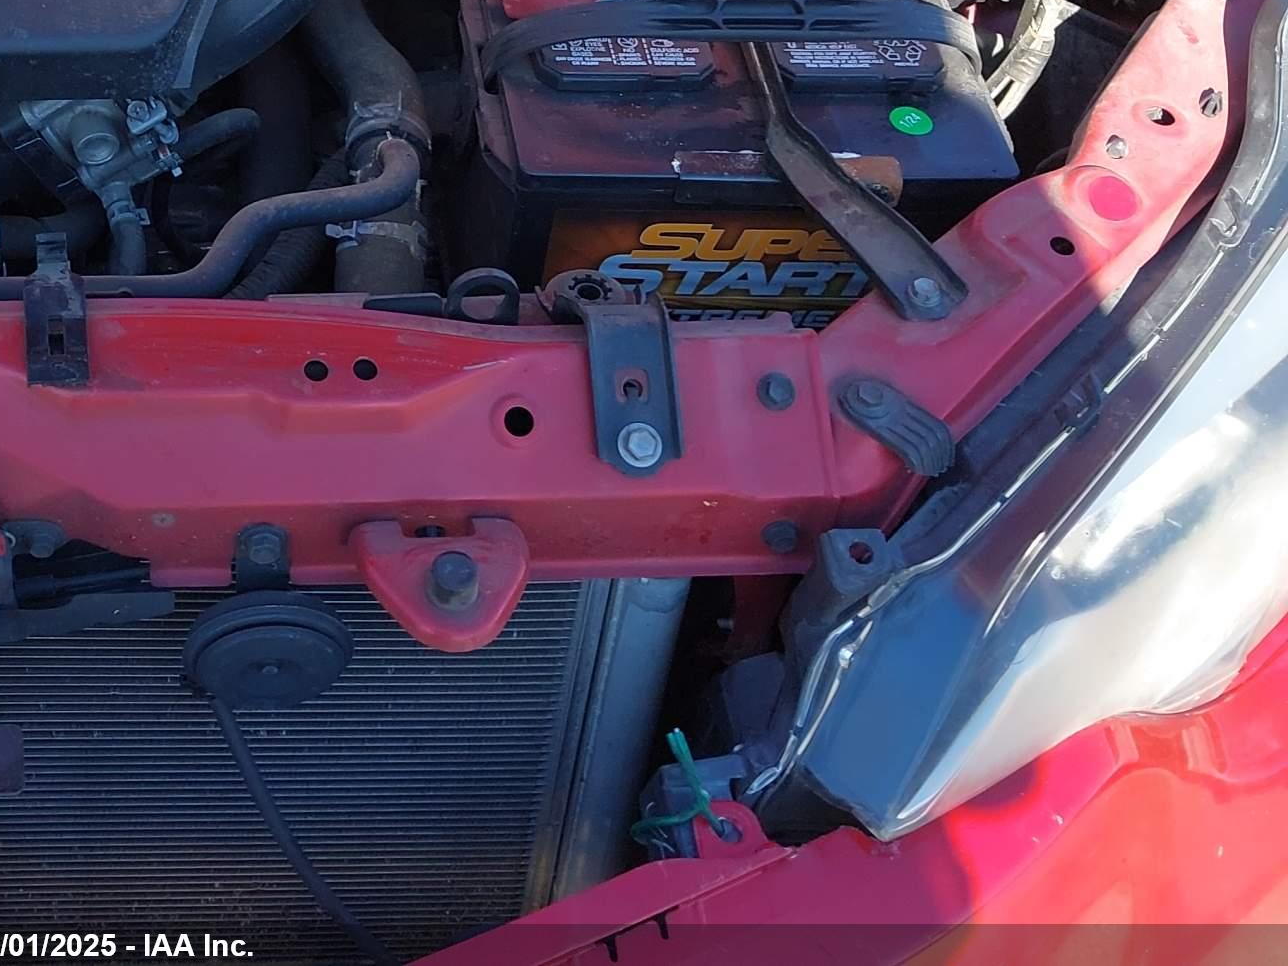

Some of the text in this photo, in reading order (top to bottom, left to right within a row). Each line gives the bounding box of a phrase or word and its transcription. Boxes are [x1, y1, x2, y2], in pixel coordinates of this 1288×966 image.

[899, 112, 922, 129] 1/24
[630, 222, 852, 262] SUPE
[598, 254, 870, 298] START
